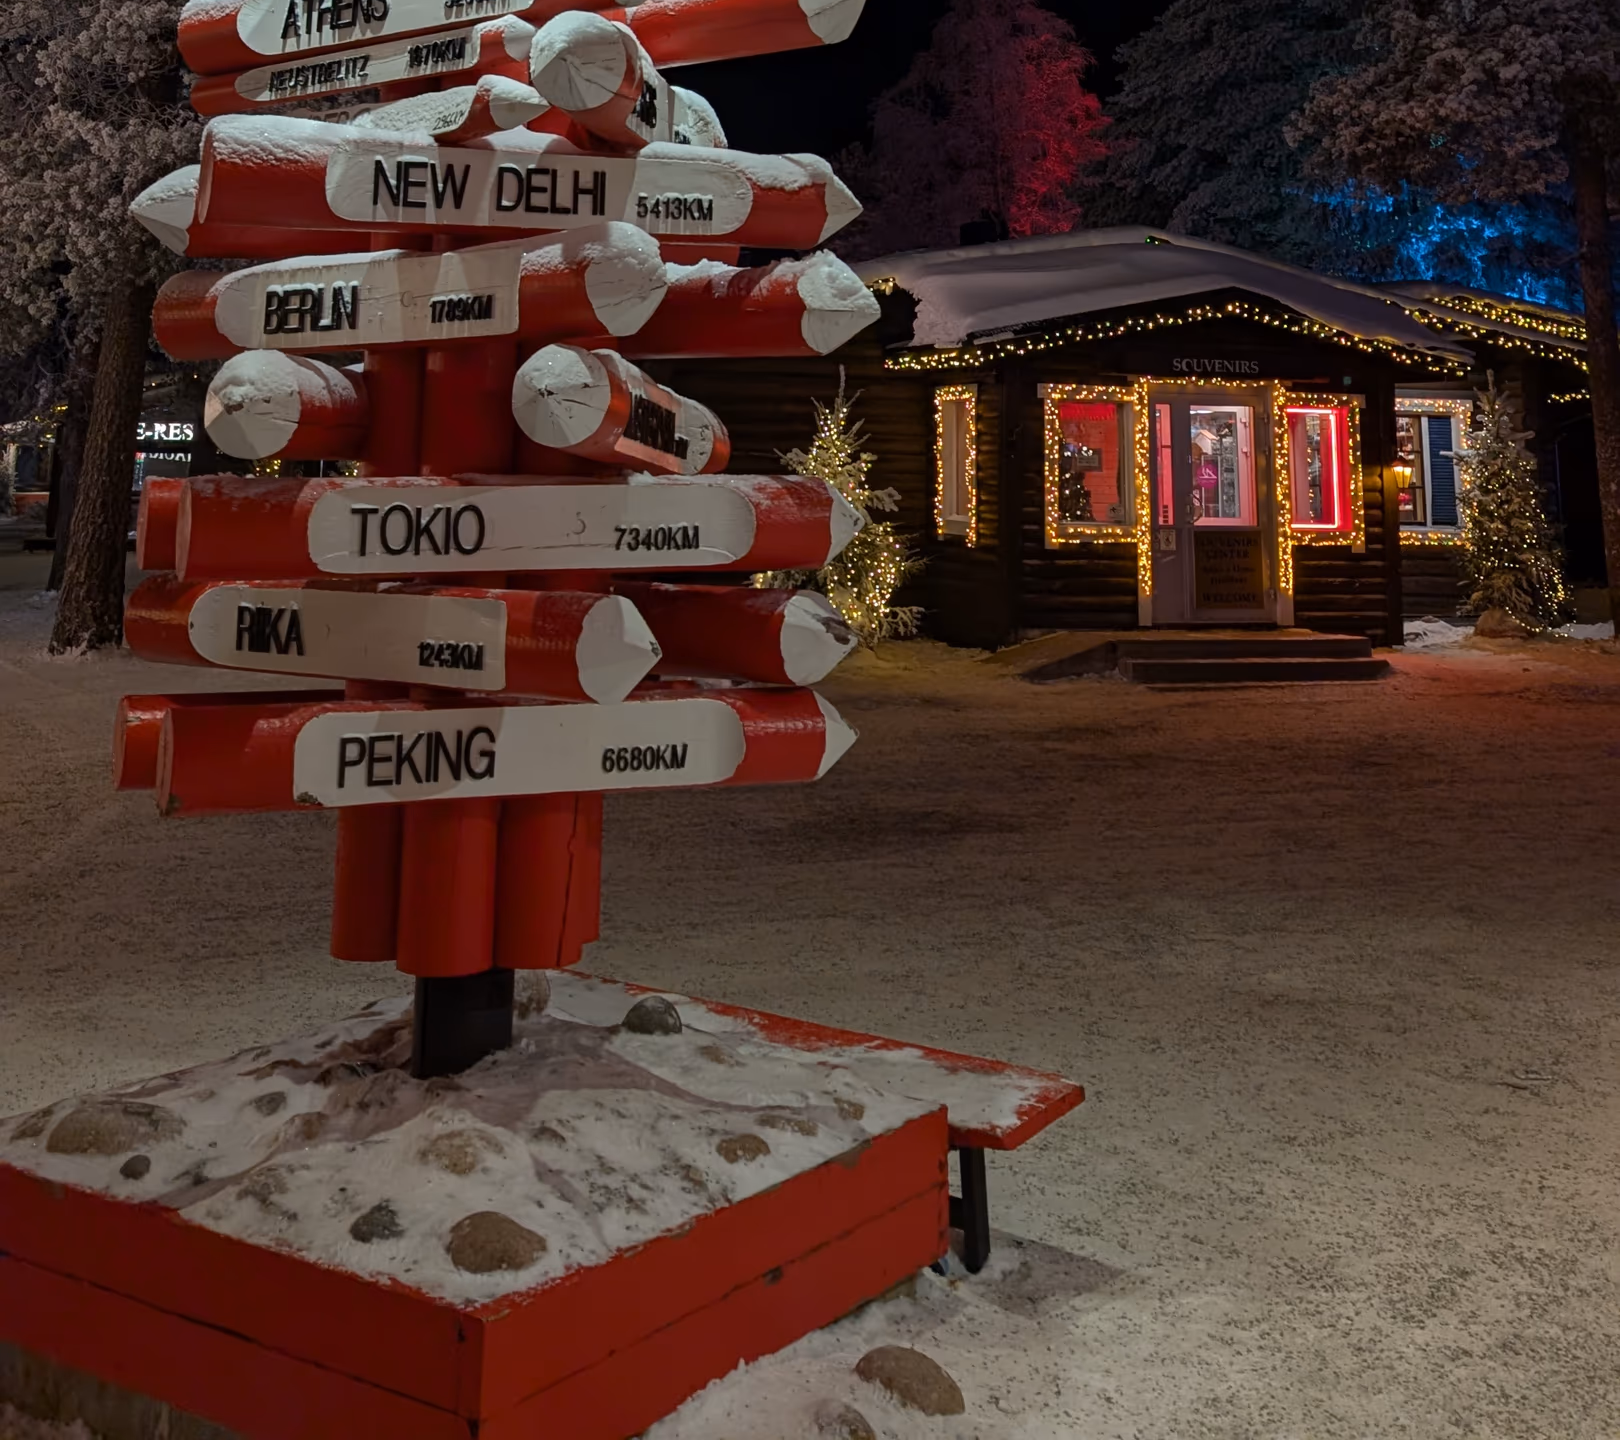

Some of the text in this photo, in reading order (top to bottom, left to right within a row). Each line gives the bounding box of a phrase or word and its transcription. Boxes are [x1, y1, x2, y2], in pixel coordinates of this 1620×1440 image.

[372, 159, 714, 221] NEW DELHI 5413KM
[264, 286, 493, 335] BERLIN 1789KM
[1172, 357, 1260, 374] SOUVENIRS
[350, 503, 700, 556] TOKIO 7340KM
[338, 727, 690, 788] PEKING 6680KM
